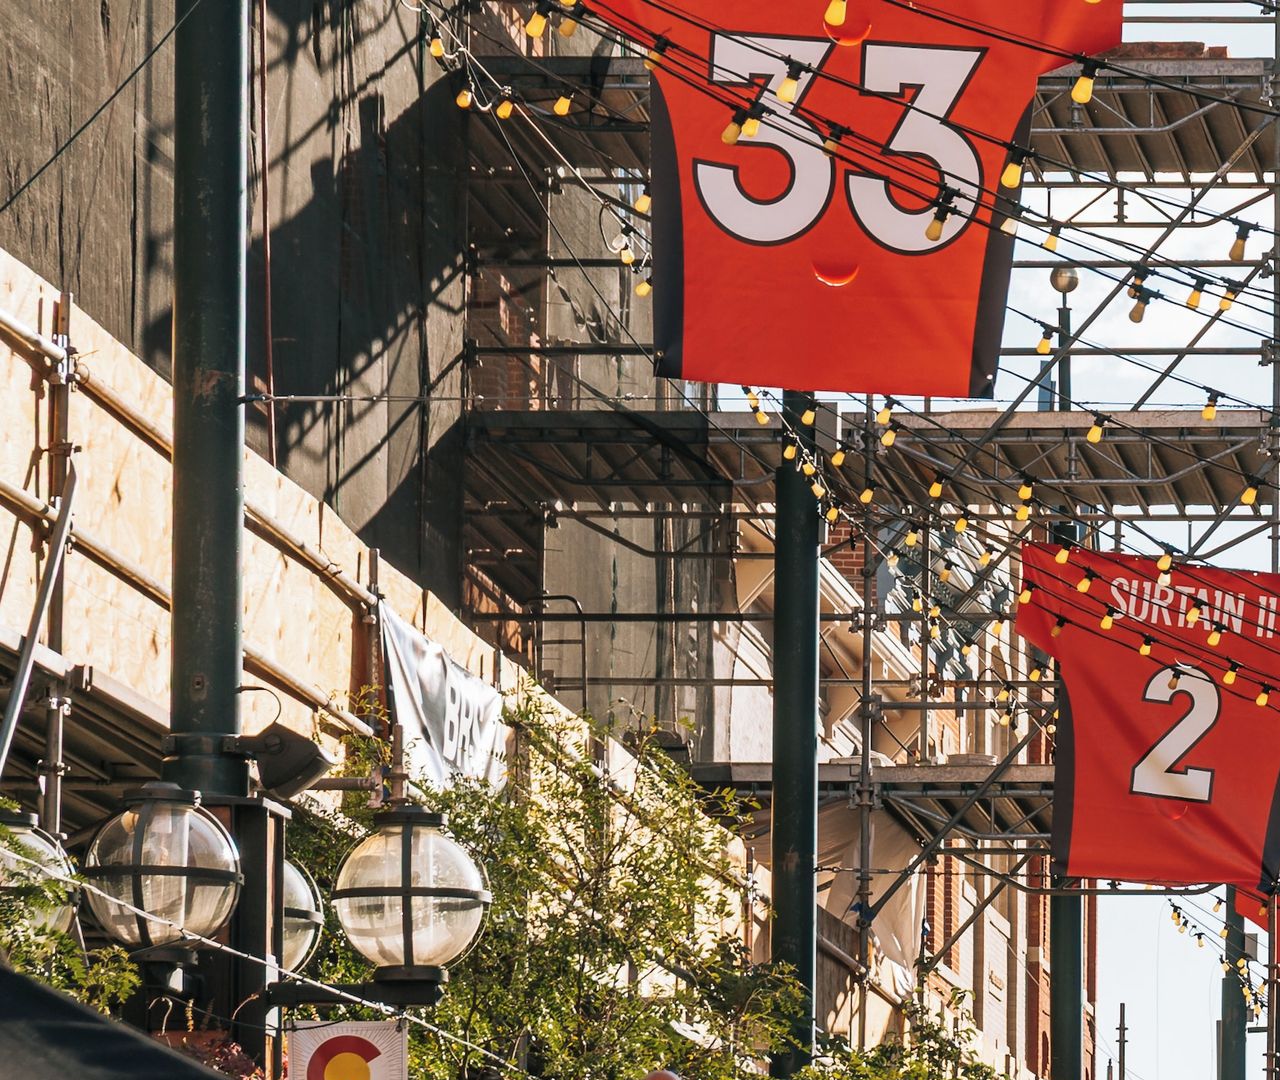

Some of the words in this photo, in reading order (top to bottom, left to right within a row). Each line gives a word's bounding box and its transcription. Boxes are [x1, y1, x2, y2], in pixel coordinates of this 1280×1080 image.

[692, 31, 989, 256] 33
[1110, 576, 1245, 635] SURTAIN
[1129, 664, 1215, 804] 2
